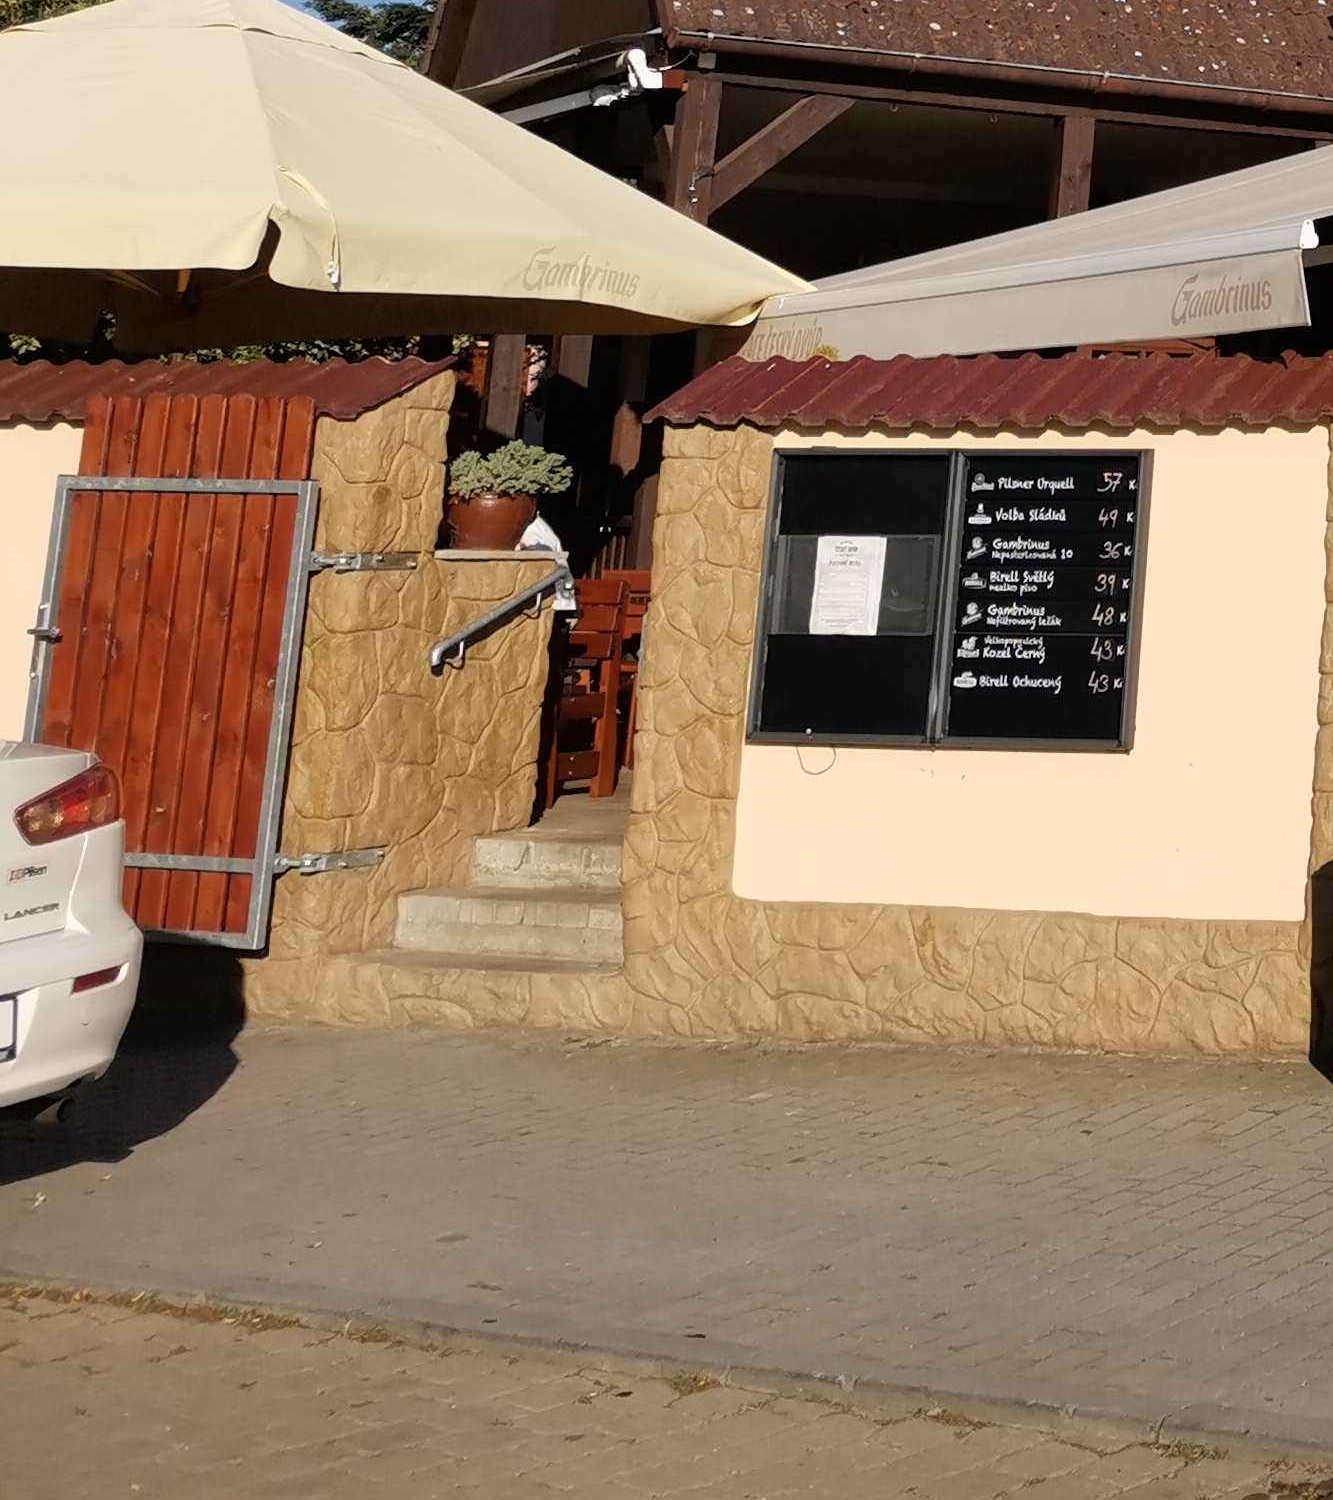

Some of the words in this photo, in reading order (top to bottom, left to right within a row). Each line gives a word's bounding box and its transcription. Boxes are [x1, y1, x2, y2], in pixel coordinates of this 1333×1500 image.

[521, 245, 640, 298] Gambrinus
[1170, 272, 1272, 326] Gambrinus
[998, 477, 1034, 490] Pilsner
[1037, 476, 1075, 495] Urquell
[1097, 473, 1123, 492] 57
[995, 507, 1024, 522] Volba
[1098, 508, 1118, 528] 49
[992, 536, 1050, 550] Gambrinus
[1061, 549, 1073, 560] 10
[1099, 541, 1123, 560] 36
[990, 570, 1019, 583] Birell
[1023, 570, 1055, 589] Světlý
[1094, 574, 1116, 596] 39
[987, 602, 1045, 617] Gambrinus
[1091, 602, 1115, 626] 48
[982, 647, 1012, 659] Kozel
[1014, 645, 1046, 664] Černý
[1090, 637, 1113, 662] 43
[979, 675, 1009, 687] Birell
[1012, 675, 1062, 695] Ochucený
[1088, 670, 1109, 694] 43
[4, 902, 60, 921] LANCER
